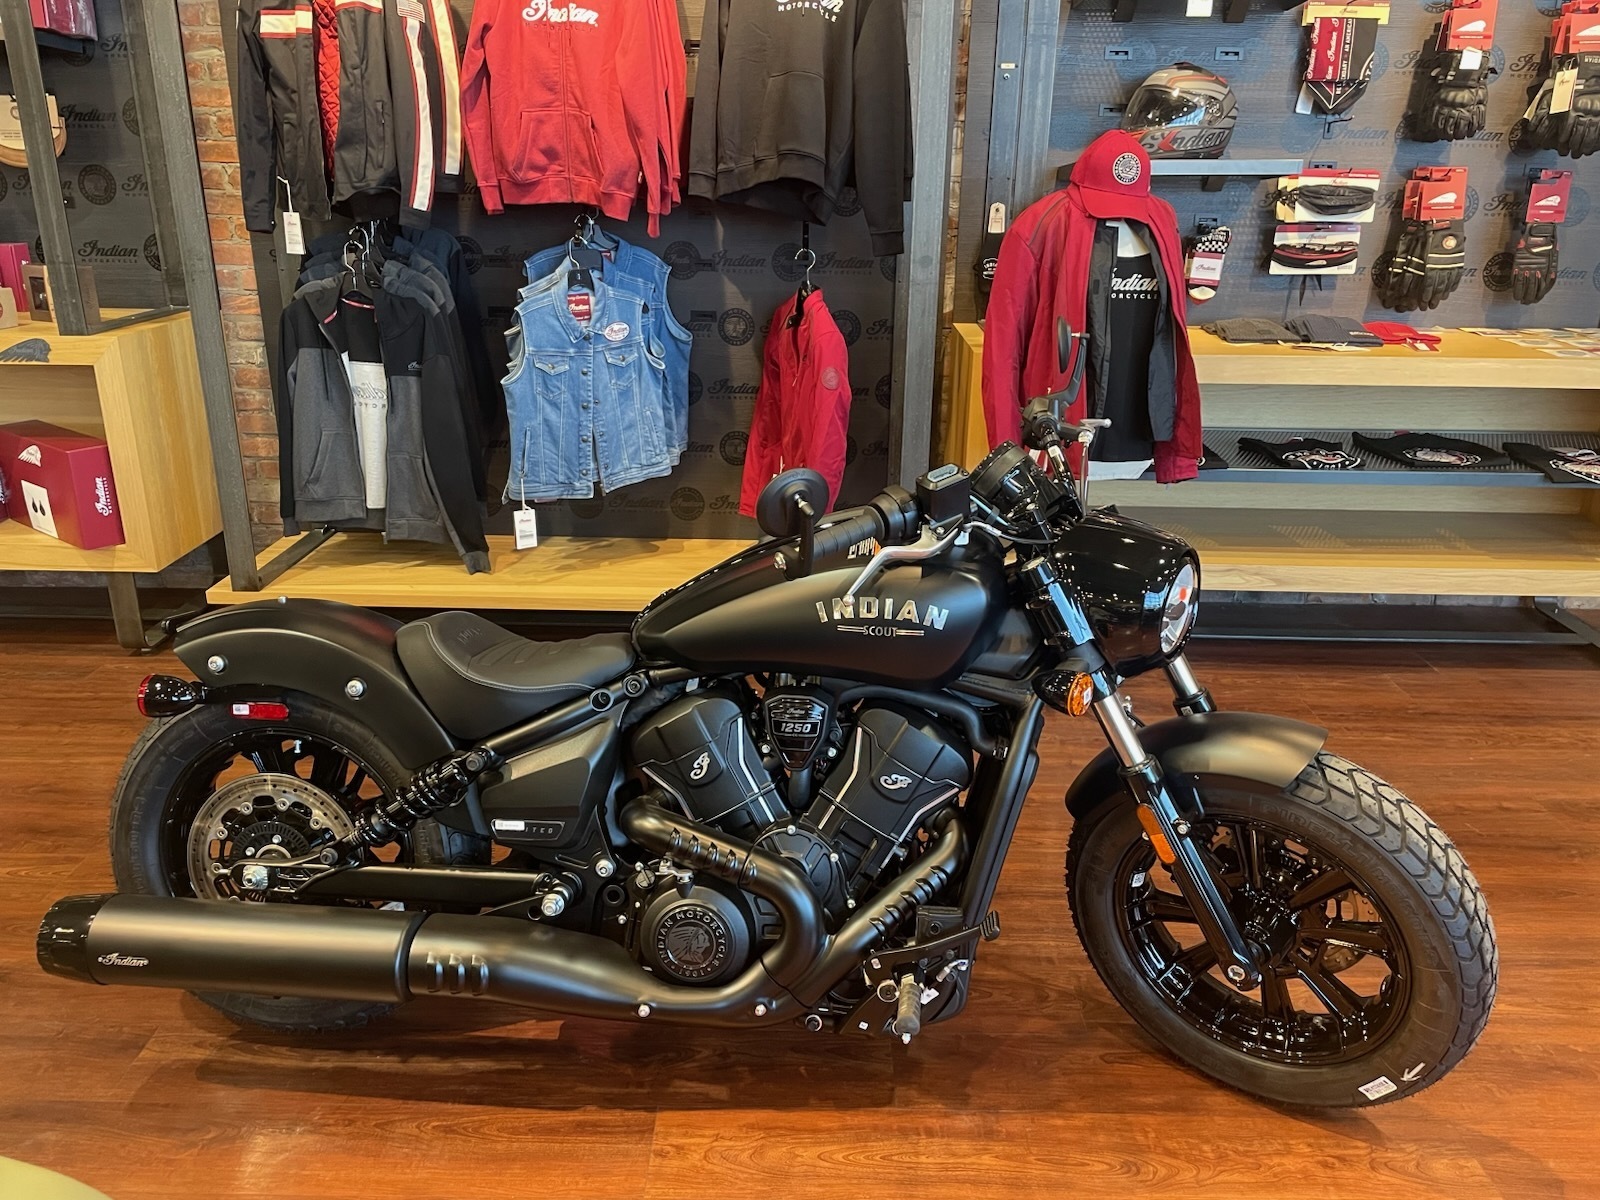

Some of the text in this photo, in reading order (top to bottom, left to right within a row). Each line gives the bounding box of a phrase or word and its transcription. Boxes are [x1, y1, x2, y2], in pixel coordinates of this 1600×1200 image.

[1327, 31, 1338, 62] Indian
[78, 240, 139, 258] Indian
[712, 250, 766, 268] Indian
[817, 251, 875, 270] Indian
[1112, 268, 1158, 291] ndian
[1111, 292, 1158, 300] ORCYCL
[95, 476, 109, 516] Indian
[815, 596, 950, 631] INDIAN
[863, 625, 898, 637] SCOUT
[780, 722, 812, 733] 1250
[525, 826, 554, 834] ITED
[101, 952, 146, 967] Indian
